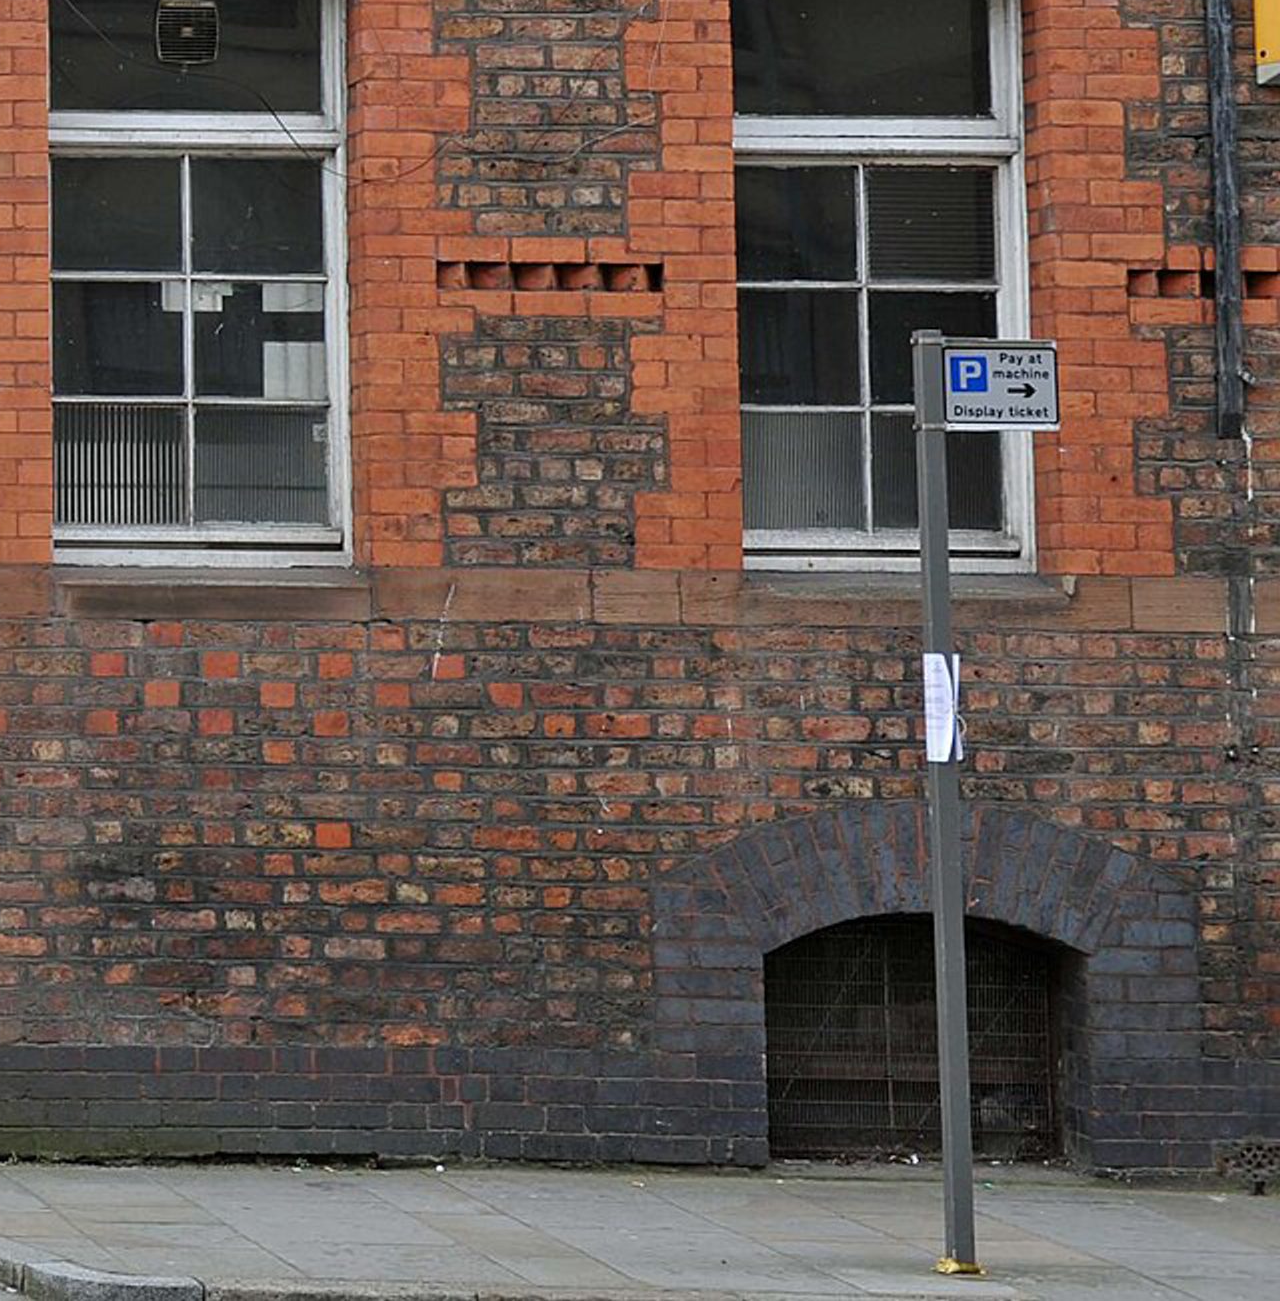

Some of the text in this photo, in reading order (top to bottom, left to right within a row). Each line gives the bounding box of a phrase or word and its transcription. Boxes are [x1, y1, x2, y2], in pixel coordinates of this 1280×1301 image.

[999, 352, 1042, 366] Pay at
[958, 360, 982, 389] P
[992, 368, 1050, 380] machine
[953, 405, 1049, 418] Display ticket
